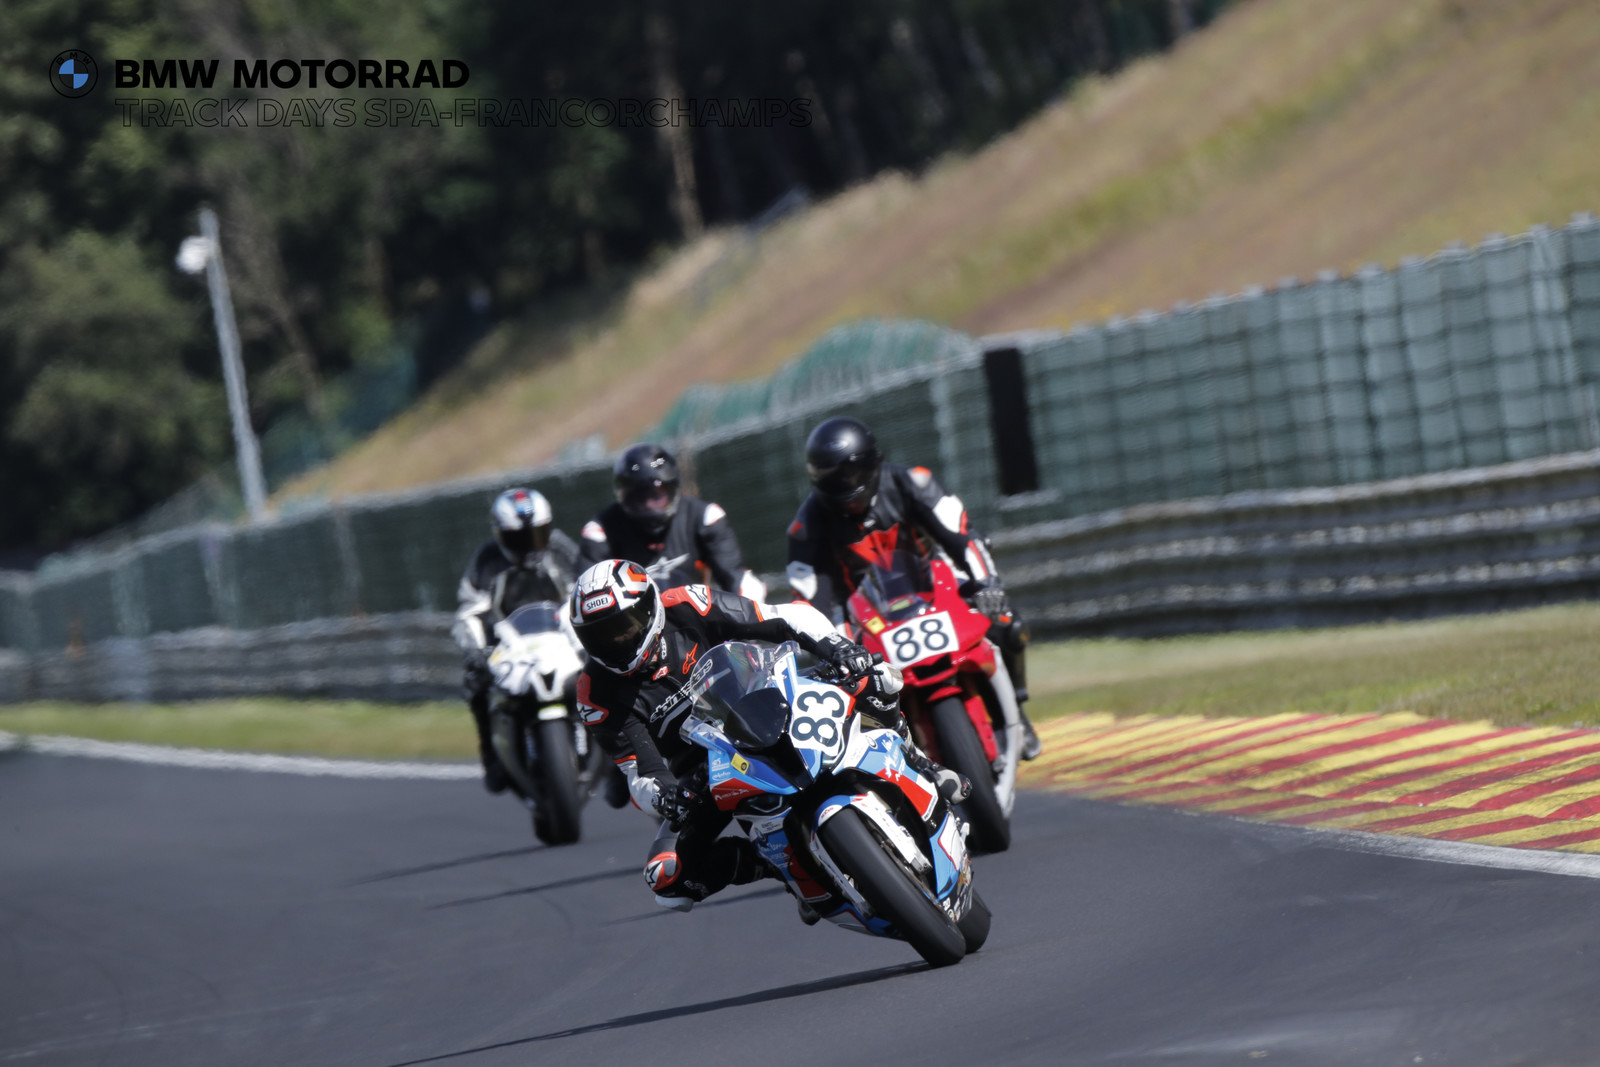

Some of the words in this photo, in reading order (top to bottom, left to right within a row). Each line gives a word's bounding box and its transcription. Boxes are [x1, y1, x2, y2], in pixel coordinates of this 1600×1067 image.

[585, 598, 609, 611] SHOEI
[892, 618, 950, 662] 88
[791, 690, 845, 747] 83
